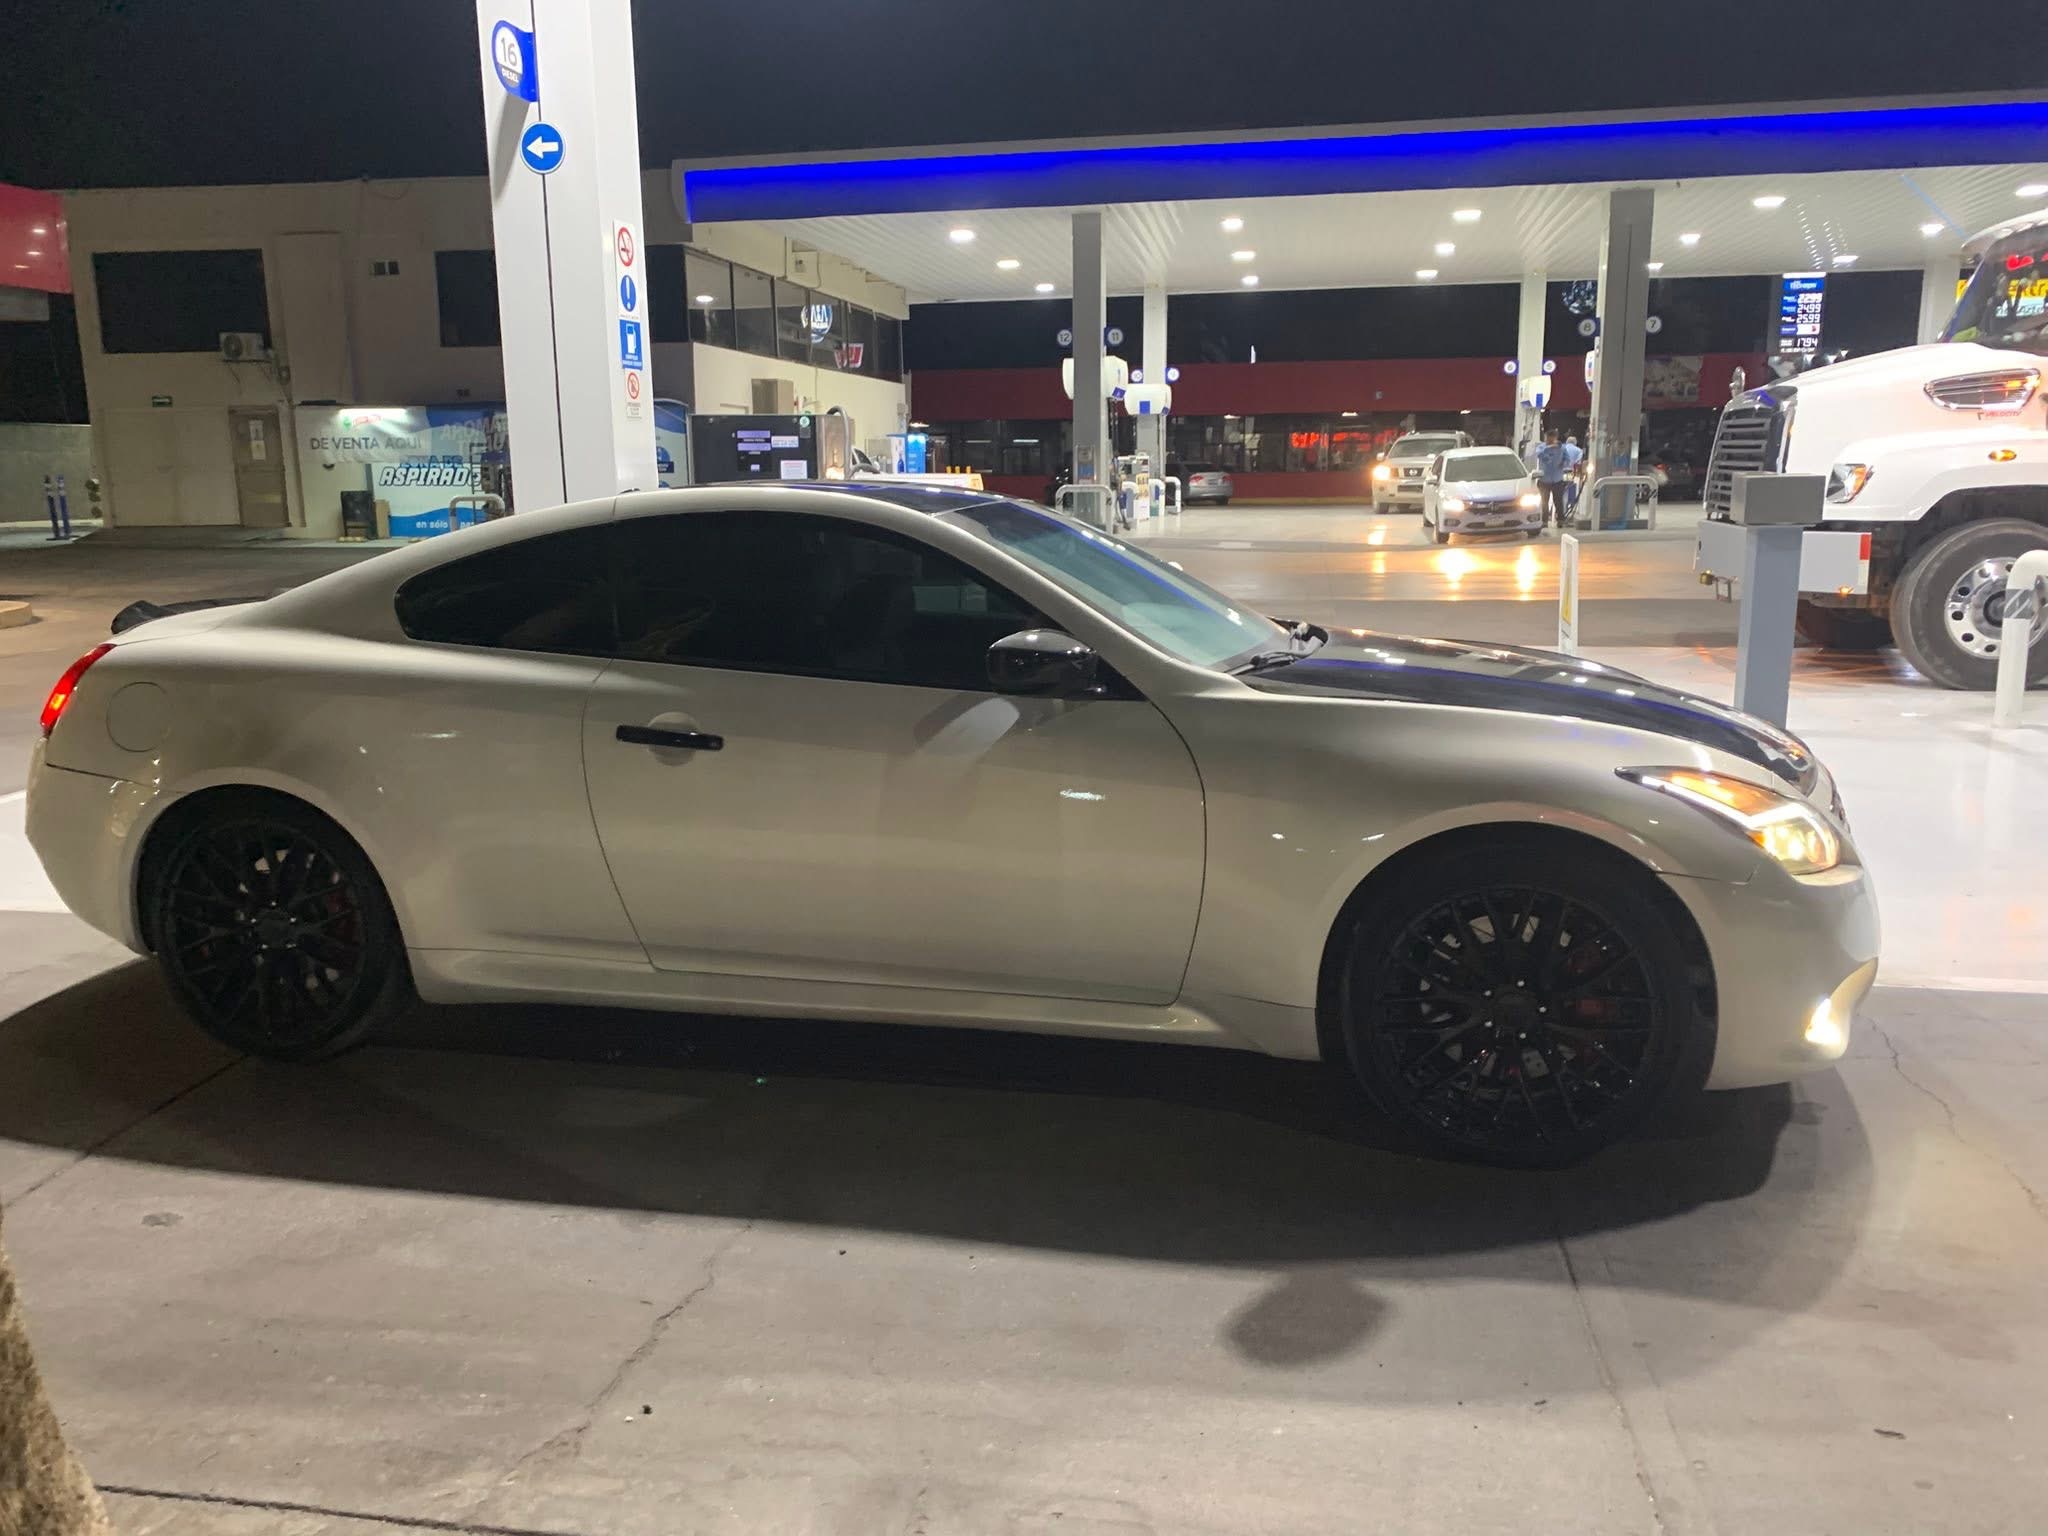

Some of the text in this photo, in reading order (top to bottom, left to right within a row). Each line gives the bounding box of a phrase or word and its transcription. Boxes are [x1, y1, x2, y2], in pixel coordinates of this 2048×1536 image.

[501, 37, 518, 67] 16
[1059, 333, 1070, 343] 12
[310, 436, 329, 450] DE
[331, 436, 380, 450] VENTA
[415, 521, 427, 529] en
[429, 519, 449, 529] sólo
